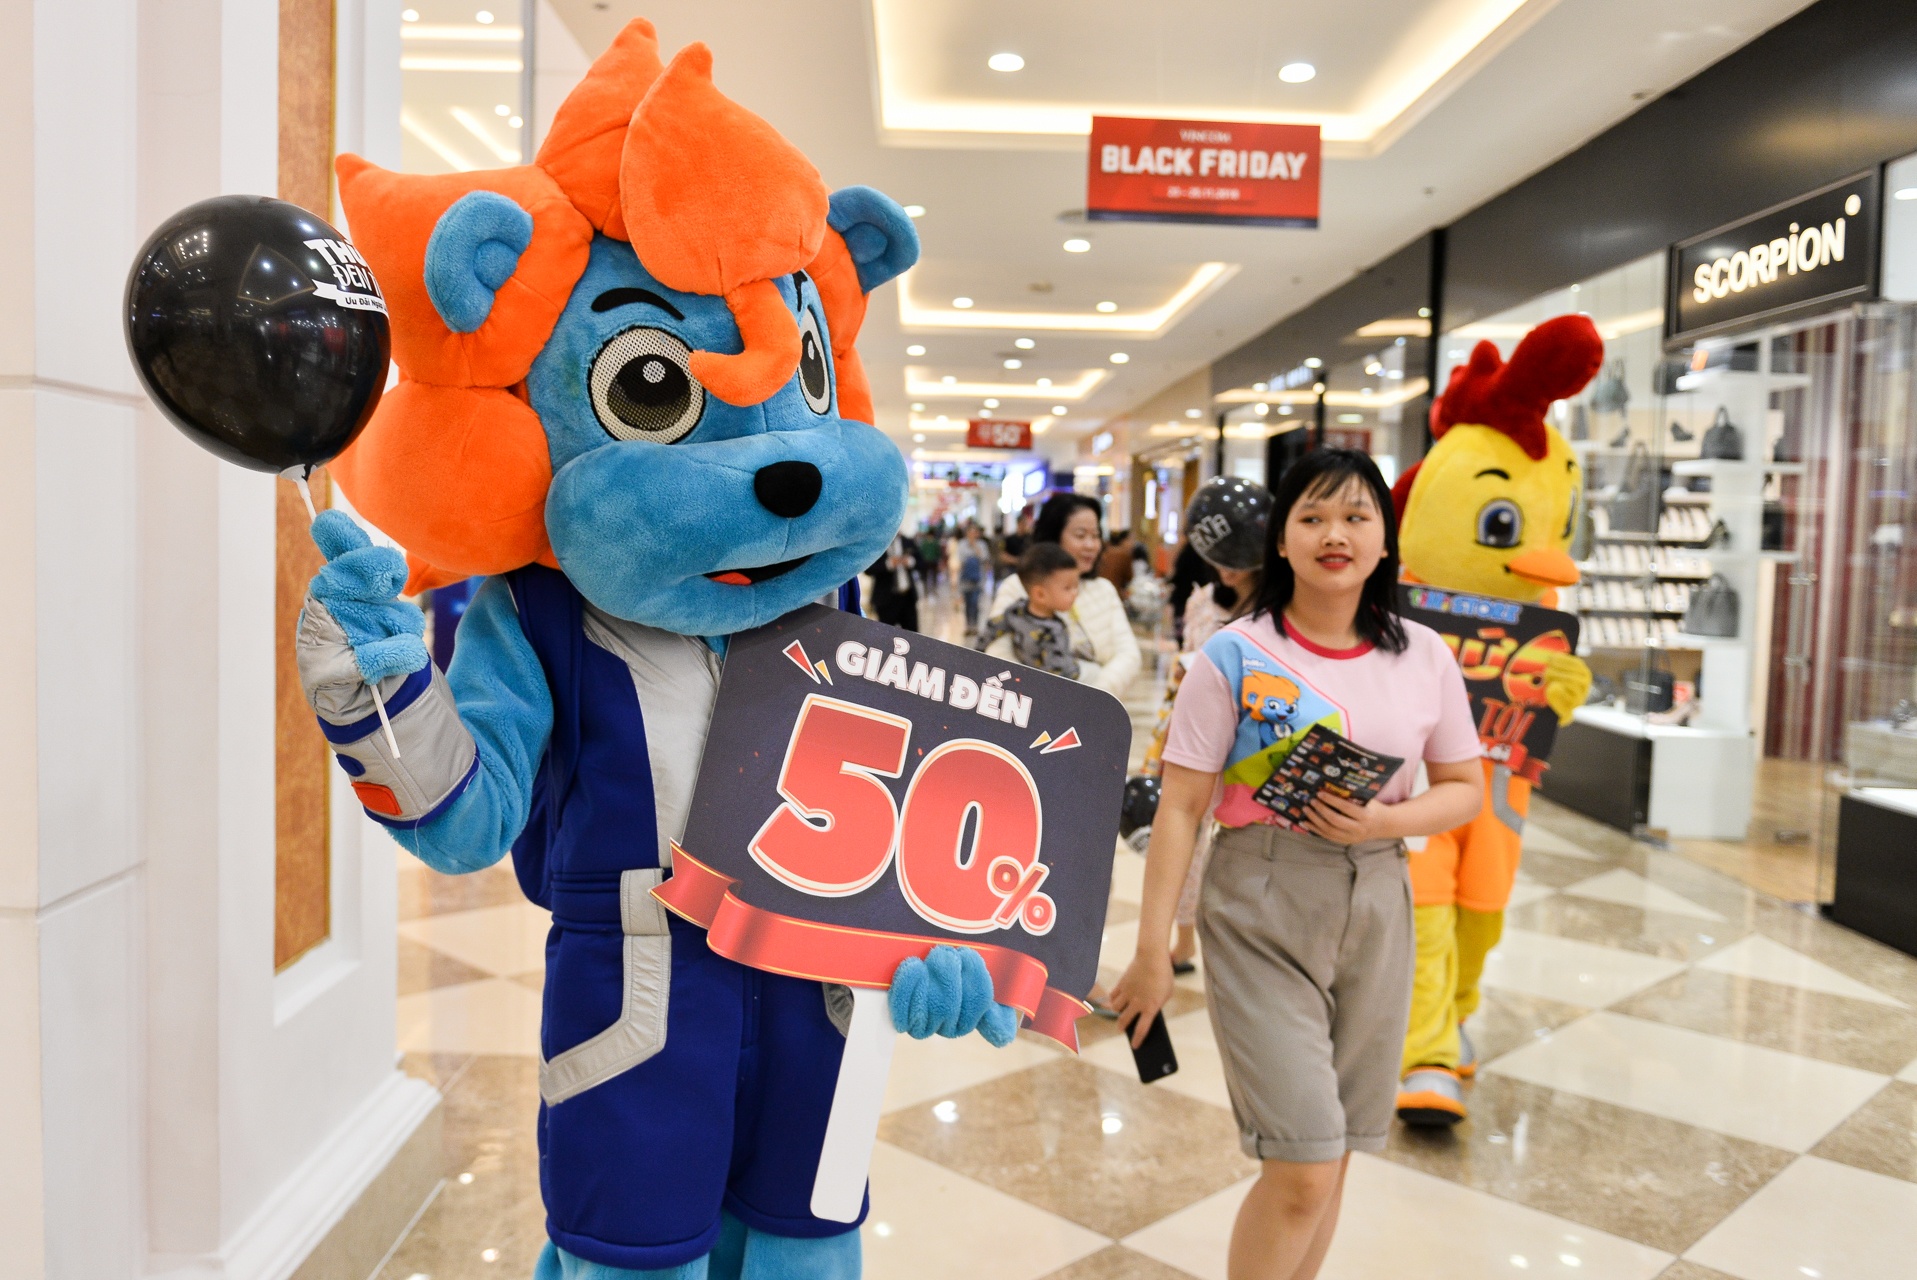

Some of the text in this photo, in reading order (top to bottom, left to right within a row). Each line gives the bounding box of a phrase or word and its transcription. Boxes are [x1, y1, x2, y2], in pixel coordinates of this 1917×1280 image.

[1101, 145, 1307, 180] BLACK FRIDAY
[836, 637, 1033, 729] GIẢM ĐẾN
[747, 692, 1056, 936] 50%
